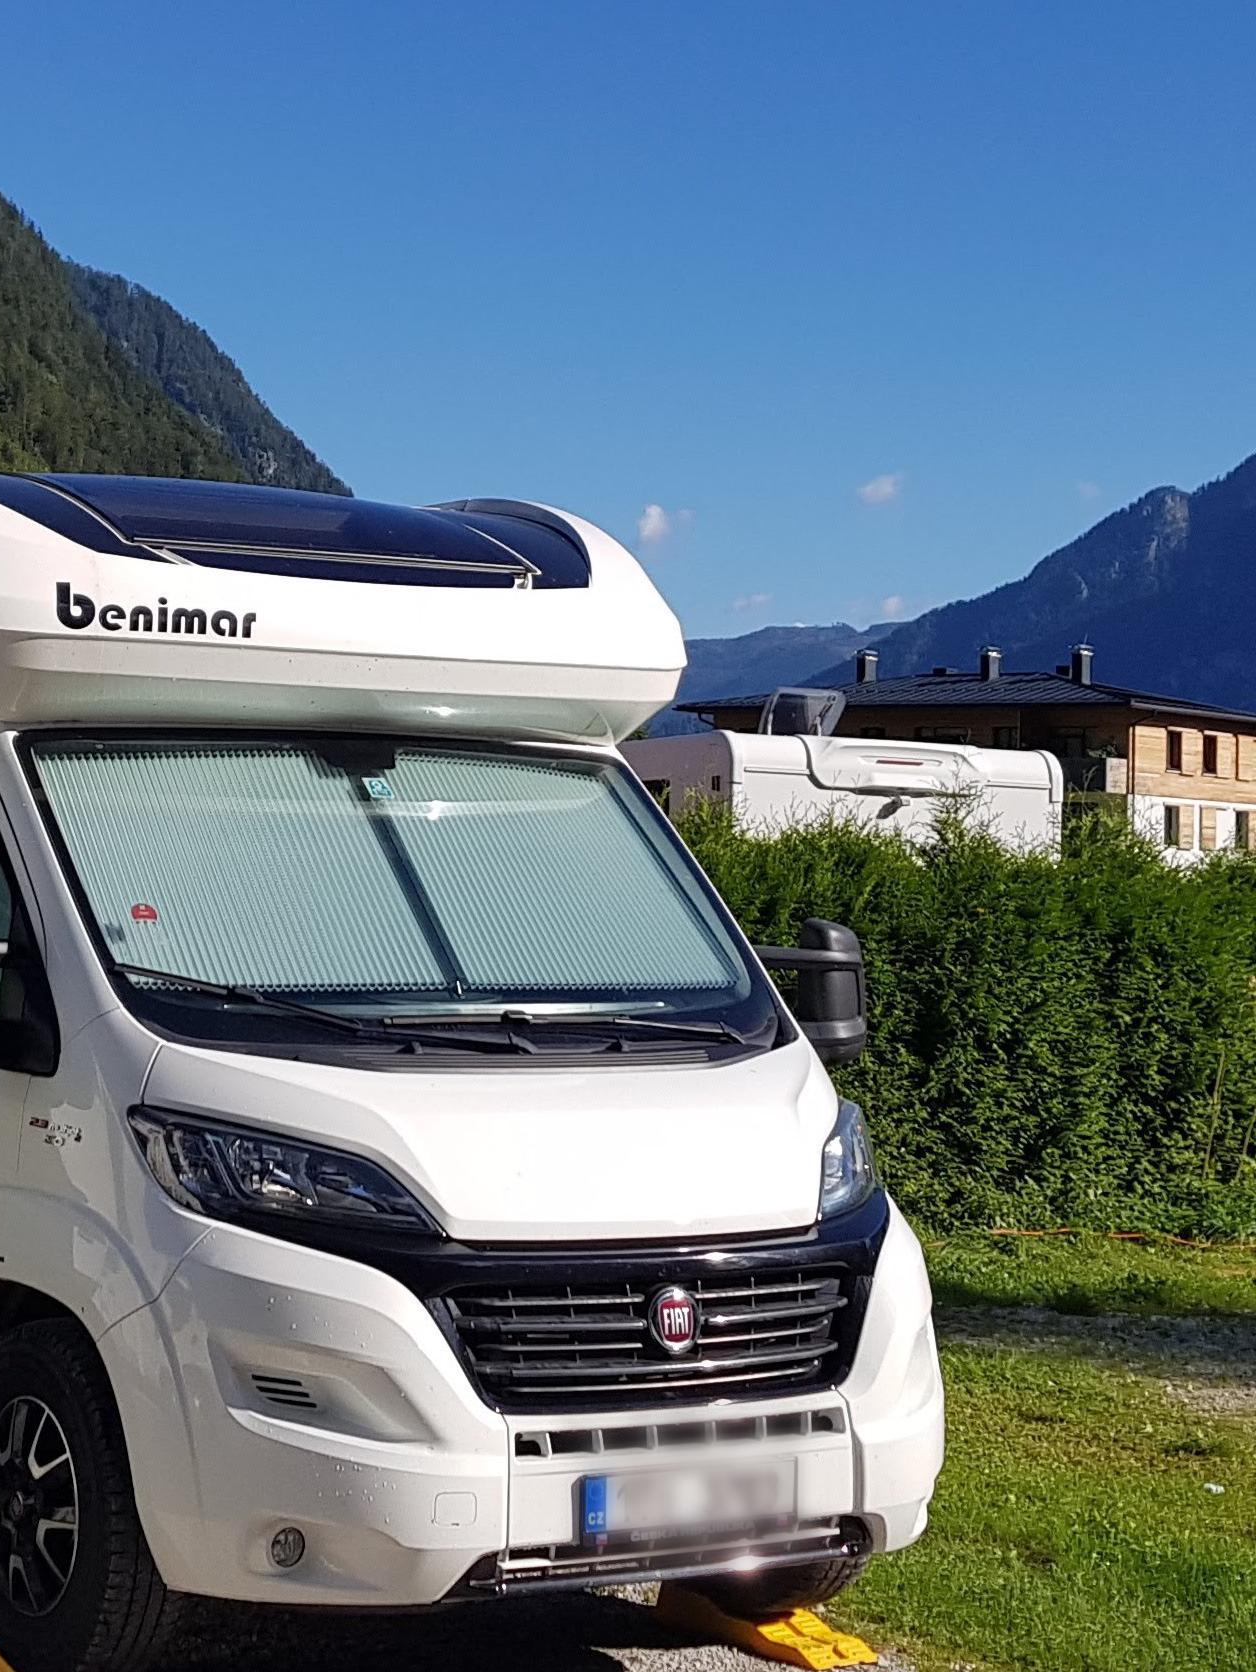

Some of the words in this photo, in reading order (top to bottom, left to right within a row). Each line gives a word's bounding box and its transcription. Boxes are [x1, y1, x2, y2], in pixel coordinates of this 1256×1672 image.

[55, 581, 257, 639] benimar
[663, 1307, 690, 1335] FIAT
[587, 1513, 604, 1526] CZ
